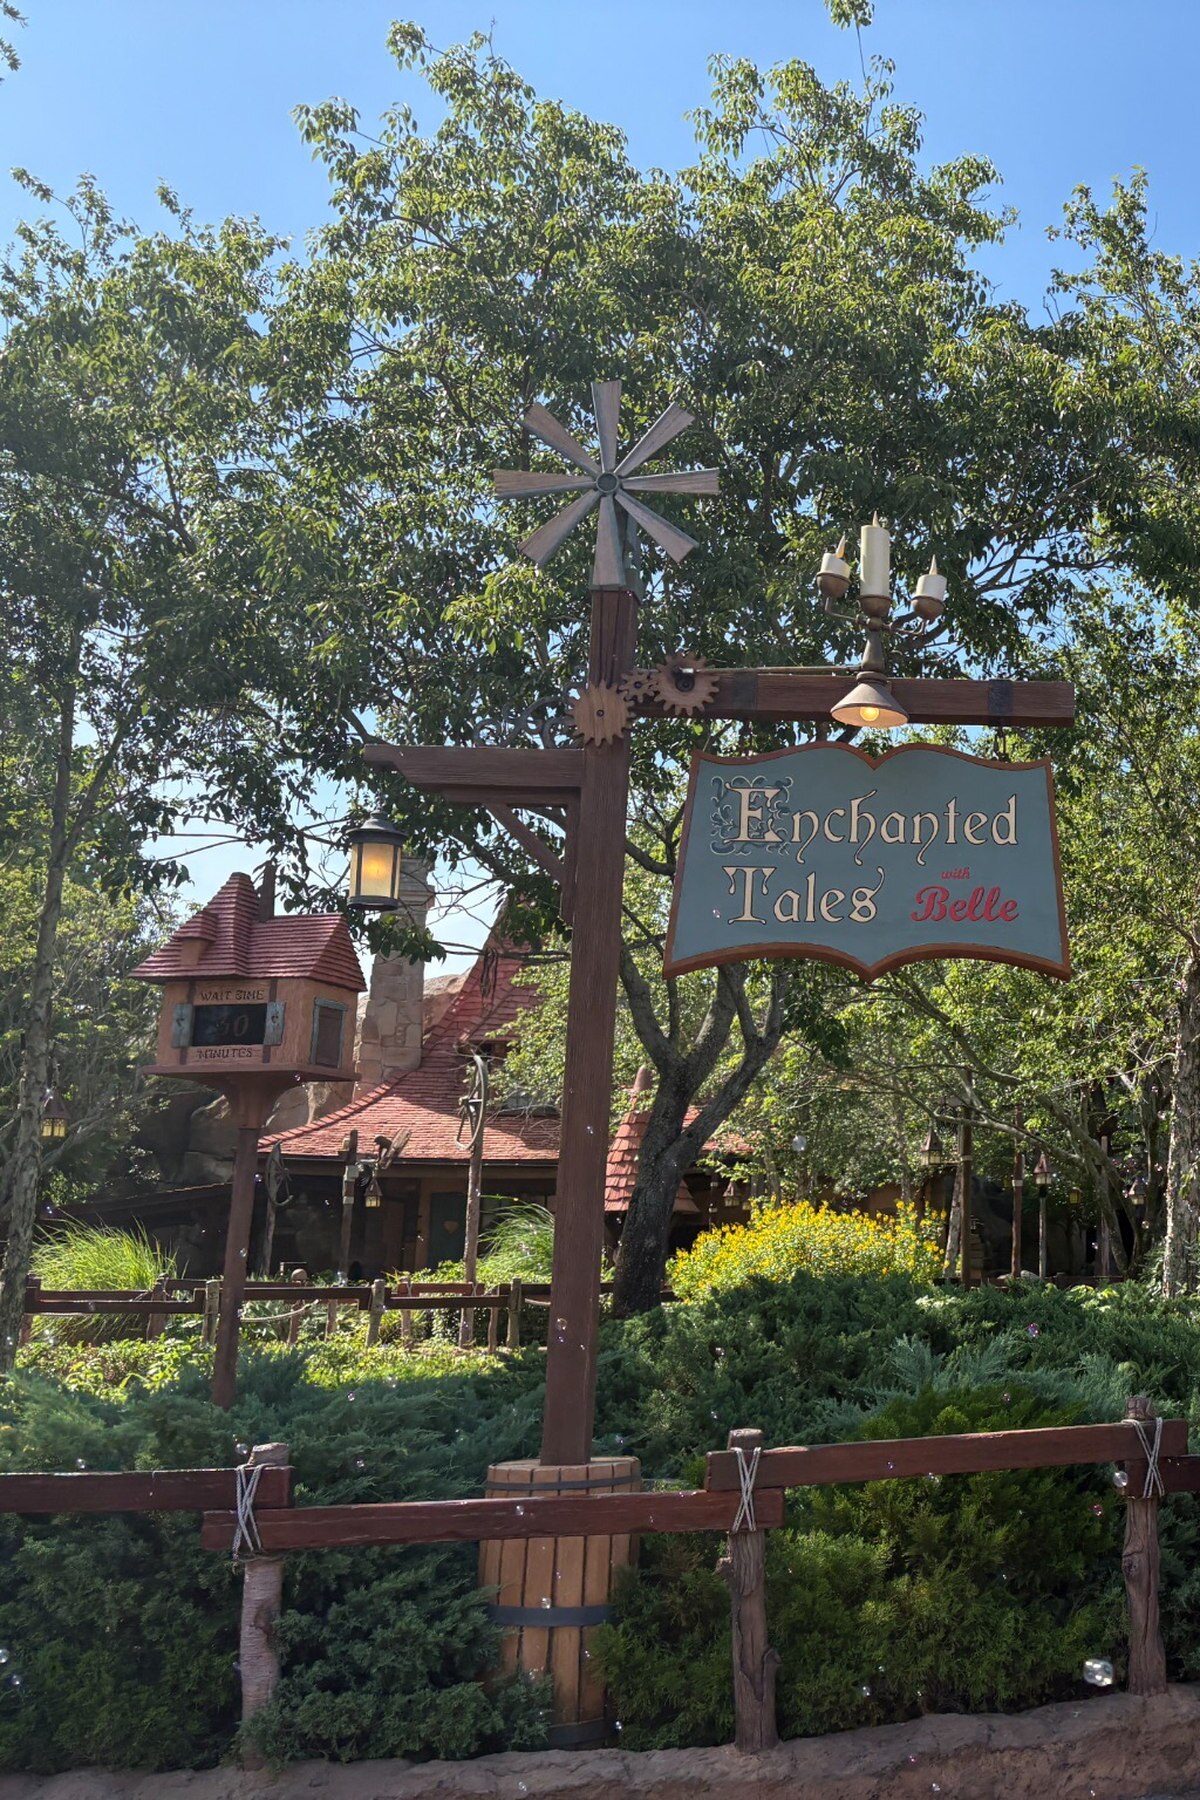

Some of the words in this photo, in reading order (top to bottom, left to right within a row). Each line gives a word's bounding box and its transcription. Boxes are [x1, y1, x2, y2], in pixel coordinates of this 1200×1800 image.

[722, 781, 1019, 866] Enchanted
[941, 867, 970, 880] with
[721, 866, 886, 925] Tales
[911, 885, 1020, 922] Belle
[200, 990, 232, 1001] WAIT
[197, 1048, 253, 1060] MINUTES
